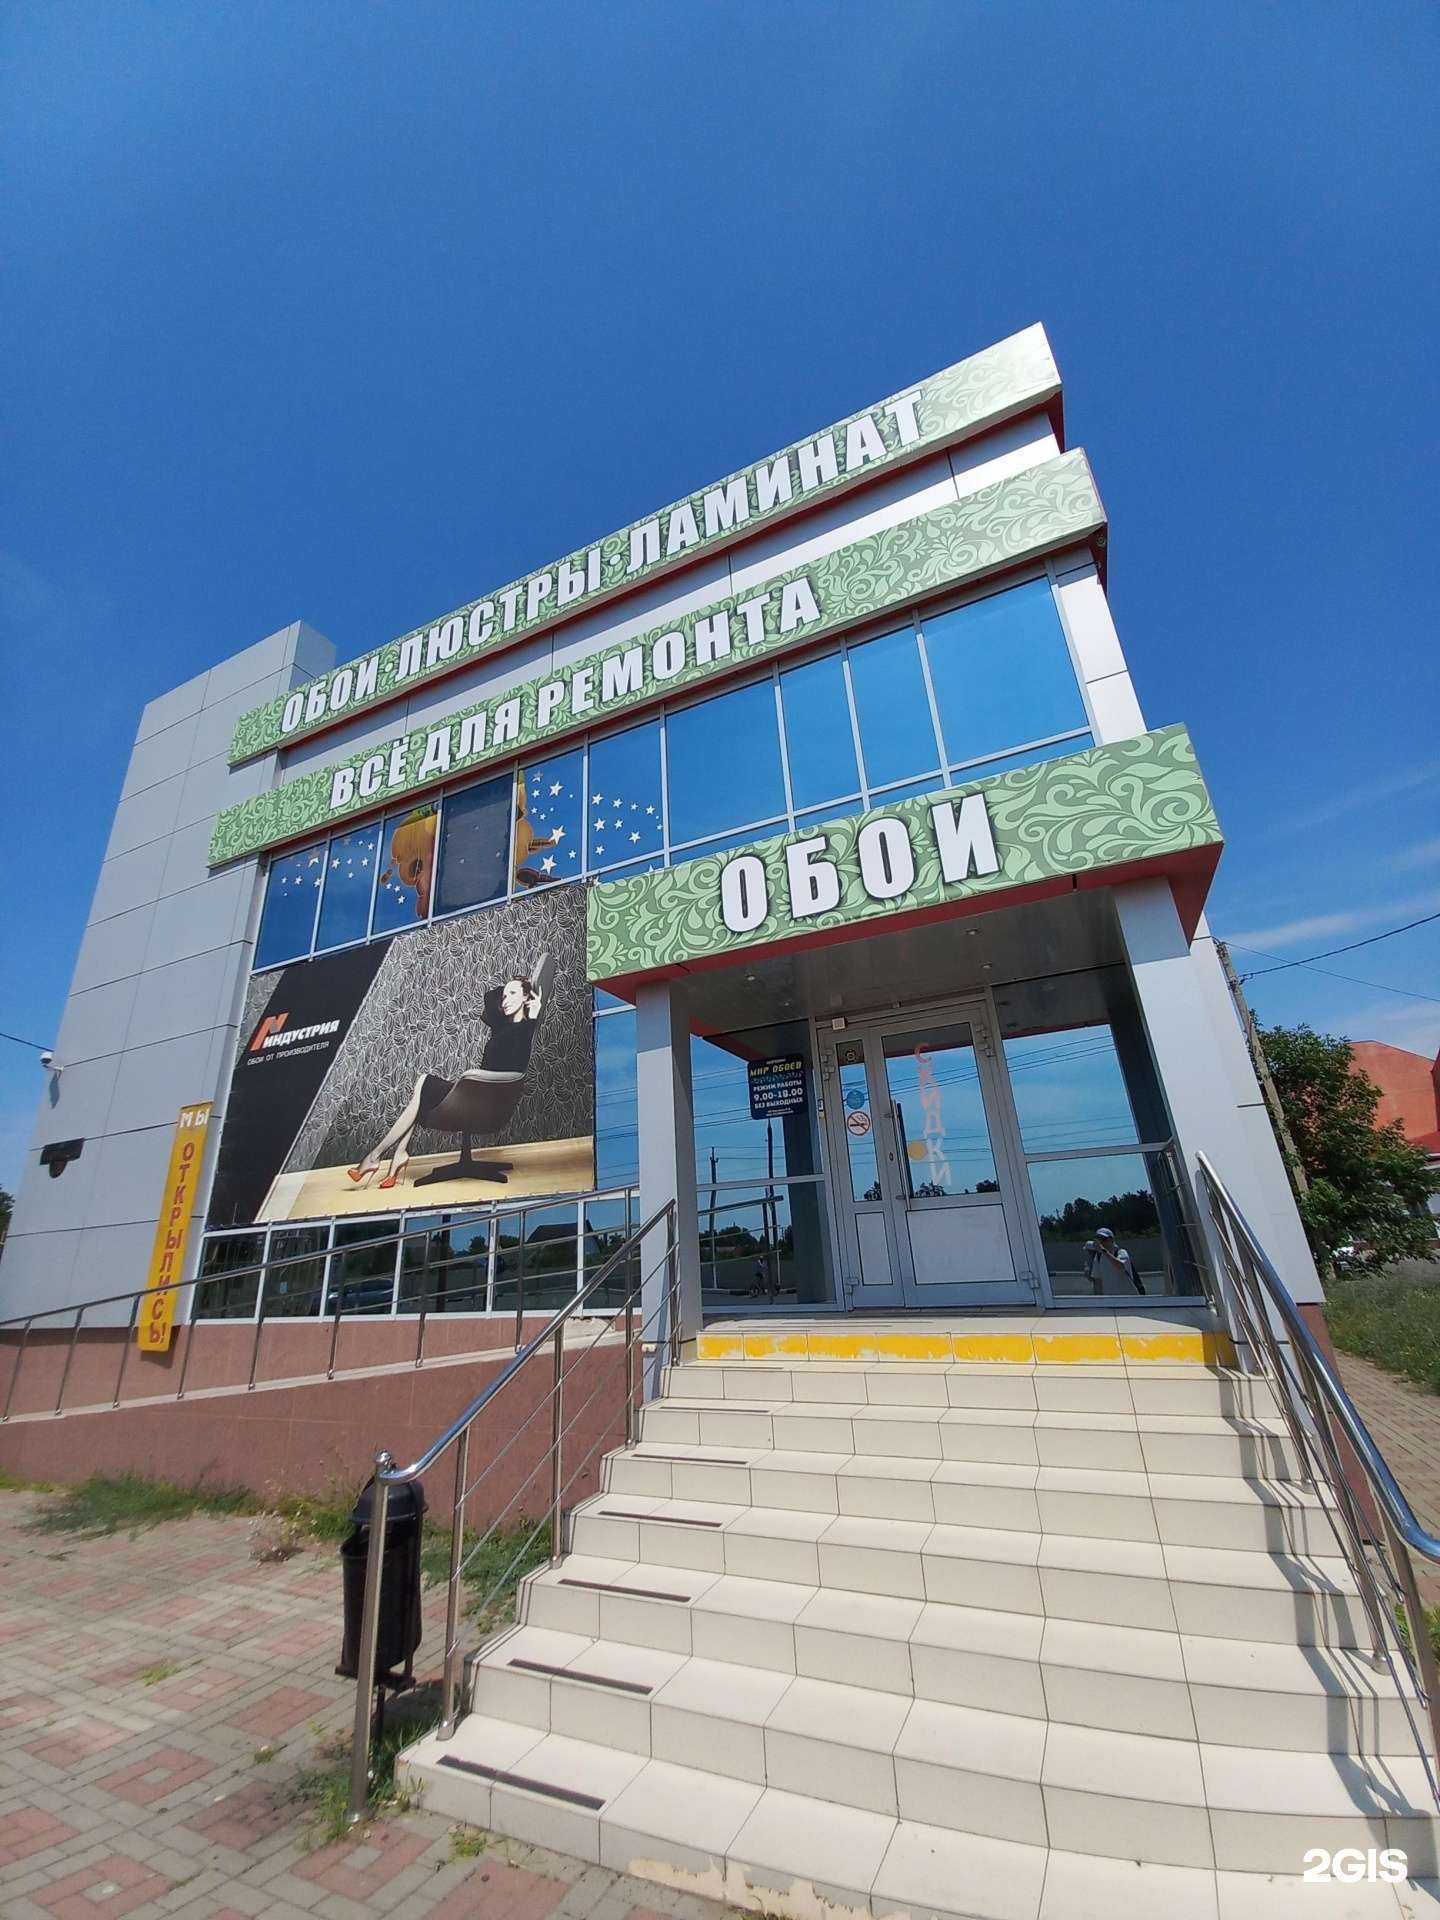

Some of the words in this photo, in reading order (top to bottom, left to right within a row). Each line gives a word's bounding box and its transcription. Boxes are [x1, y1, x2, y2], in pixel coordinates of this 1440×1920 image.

[281, 656, 380, 733] ОБОИ
[396, 548, 602, 679] ЛЮСТРЫ
[625, 390, 923, 574] ЛАМИНАТ
[329, 736, 407, 809] ВСЁ
[418, 697, 521, 781] ДЛЯ
[537, 576, 821, 728] РЕМОНТА
[720, 793, 1000, 932] ОБОИ
[247, 1055, 265, 1066] ОБОИ
[276, 1040, 330, 1059] ПРОИЗВОДИТЕЛЯ
[262, 1019, 341, 1049] ИНДУСТРИЯ
[179, 1108, 210, 1129] МЫ
[753, 1088, 803, 1101] 9.00-18.00
[915, 1042, 952, 1187] СКИДКИ
